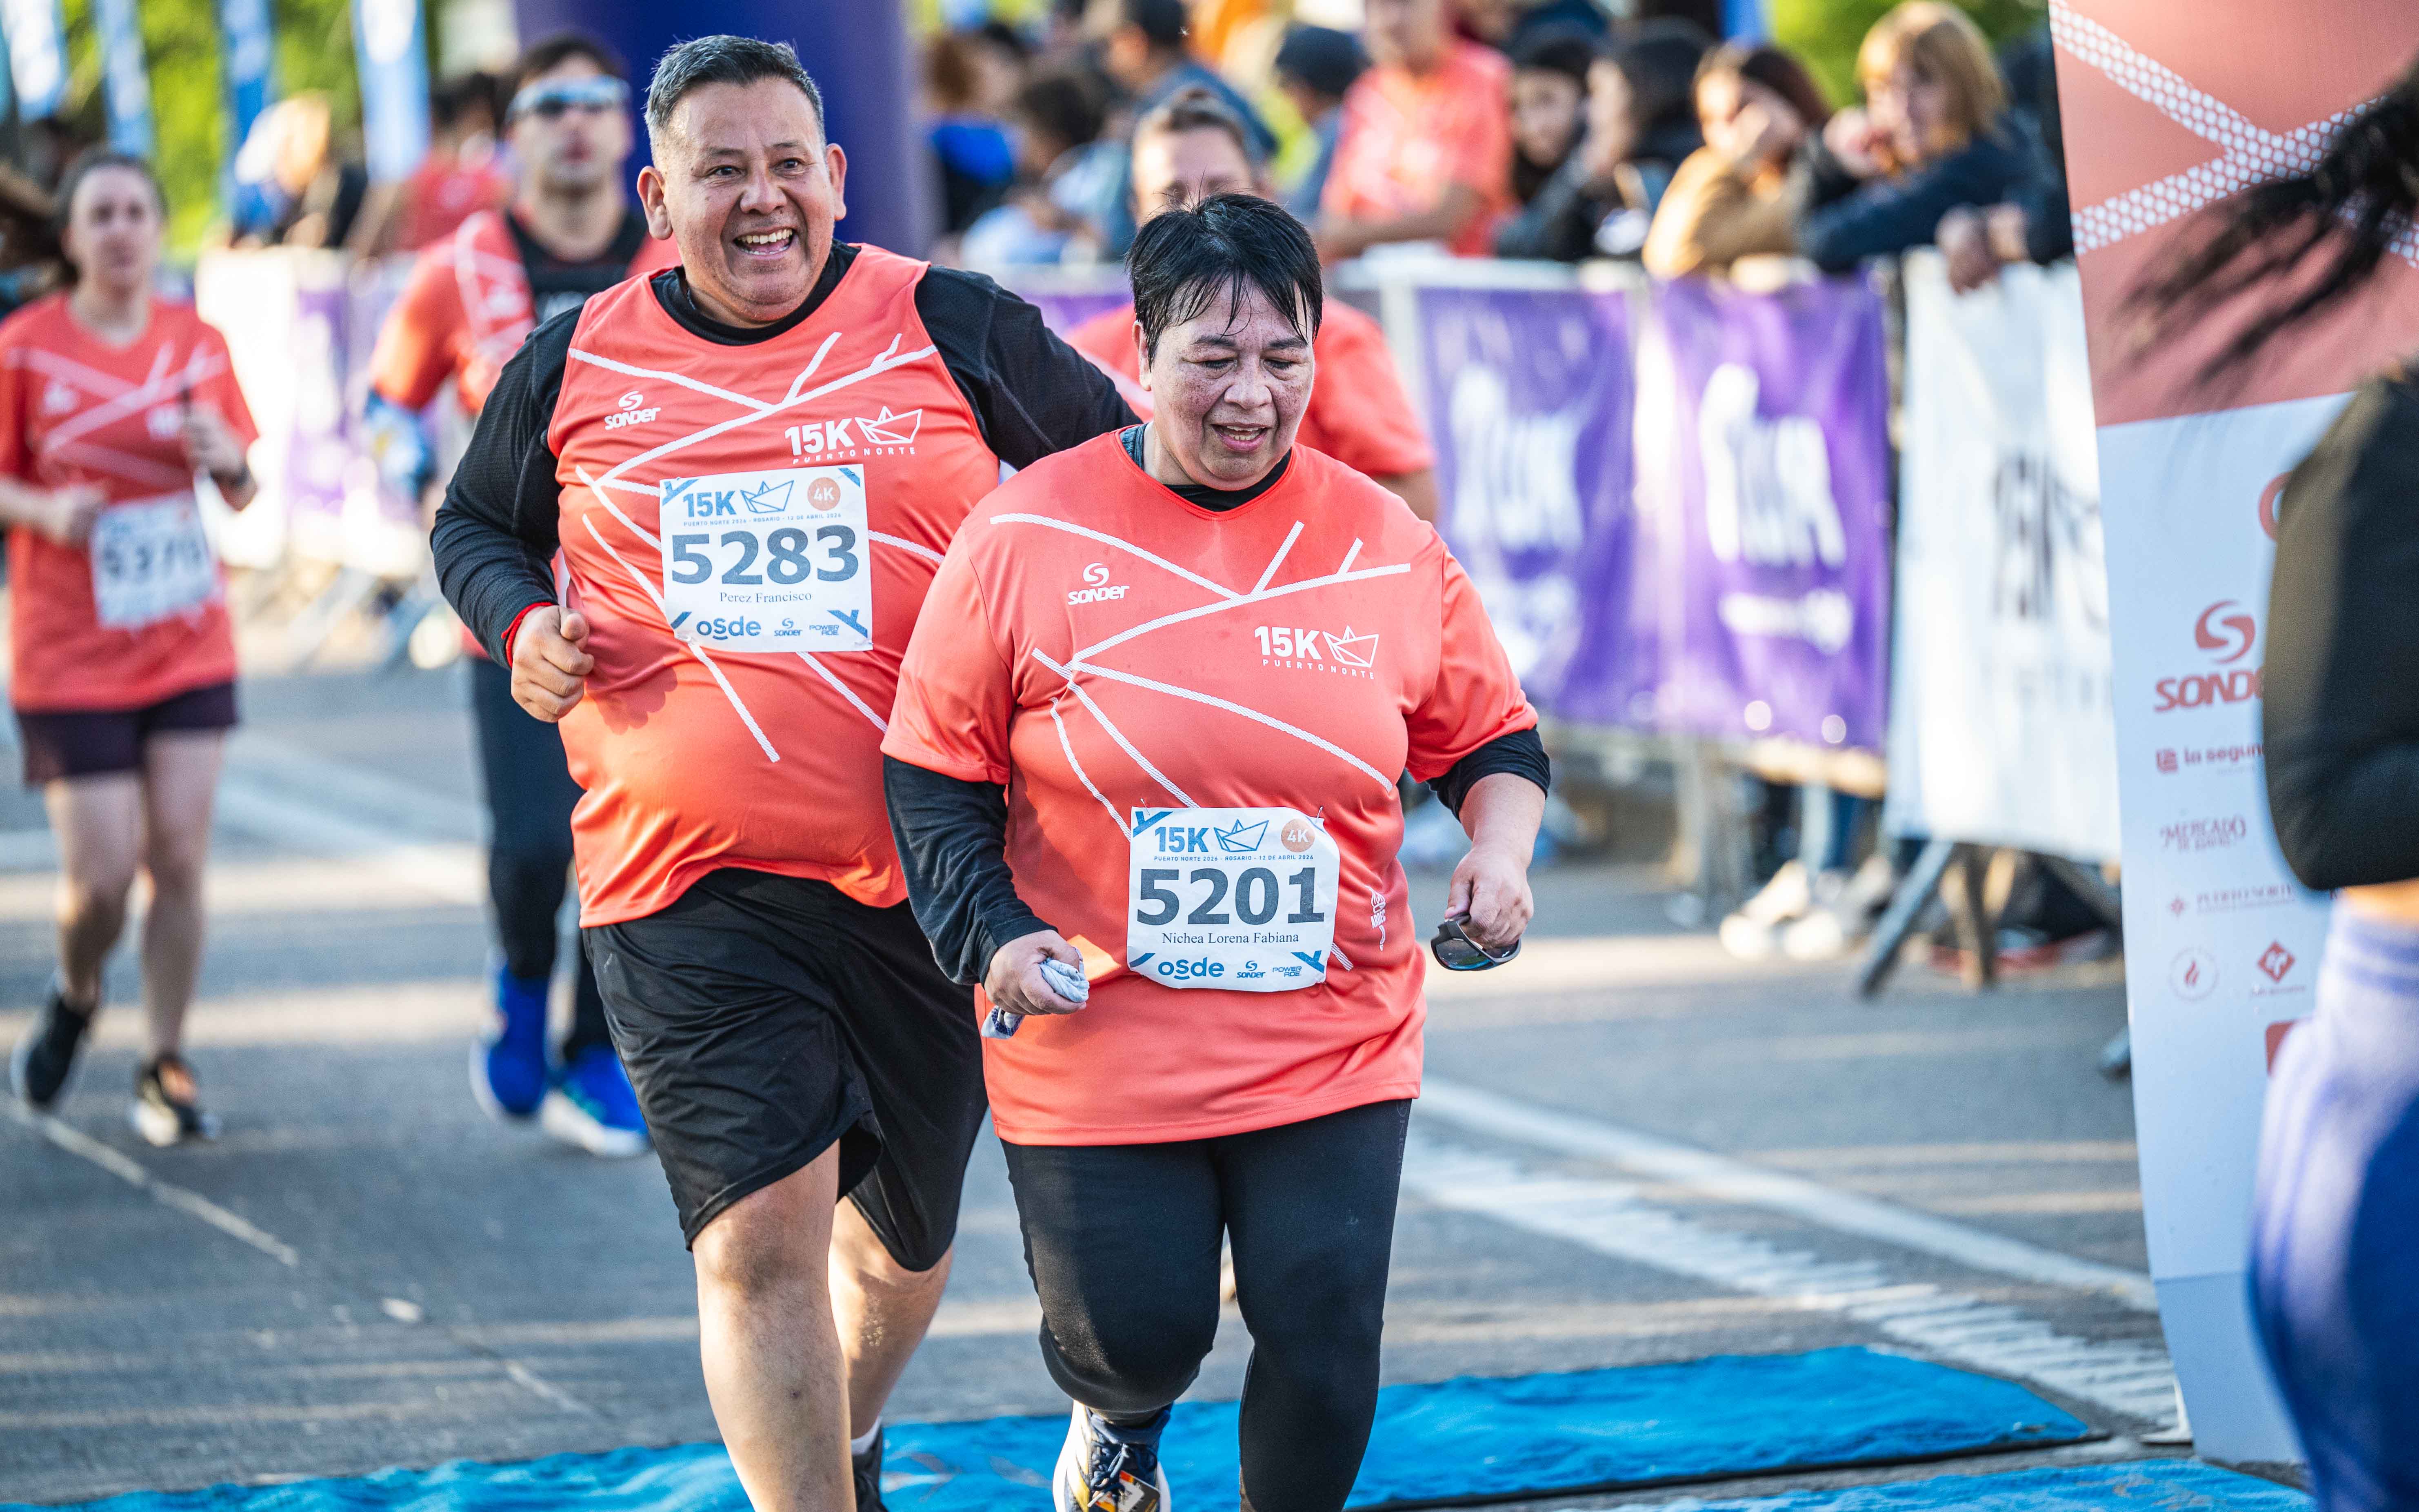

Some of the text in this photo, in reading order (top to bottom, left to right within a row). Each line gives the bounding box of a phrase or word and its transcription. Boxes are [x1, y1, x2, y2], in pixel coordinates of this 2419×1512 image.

[784, 418, 855, 456] 15K
[793, 447, 915, 464] PUERTO NORTE
[682, 490, 737, 518] 15K
[813, 486, 835, 502] 4K
[672, 524, 859, 585] 5283
[720, 591, 812, 603] Perez Francisco
[696, 615, 762, 637] osde
[1254, 626, 1322, 660] 15K
[1262, 659, 1375, 680] PUERTO NORTE
[2206, 744, 2264, 763] segun
[1154, 826, 1210, 853] 15K
[1286, 829, 1310, 843] 4K
[1137, 867, 1325, 926] 5201
[1162, 931, 1299, 944] Nichea Lorena Fabiana
[1157, 957, 1225, 979] osde
